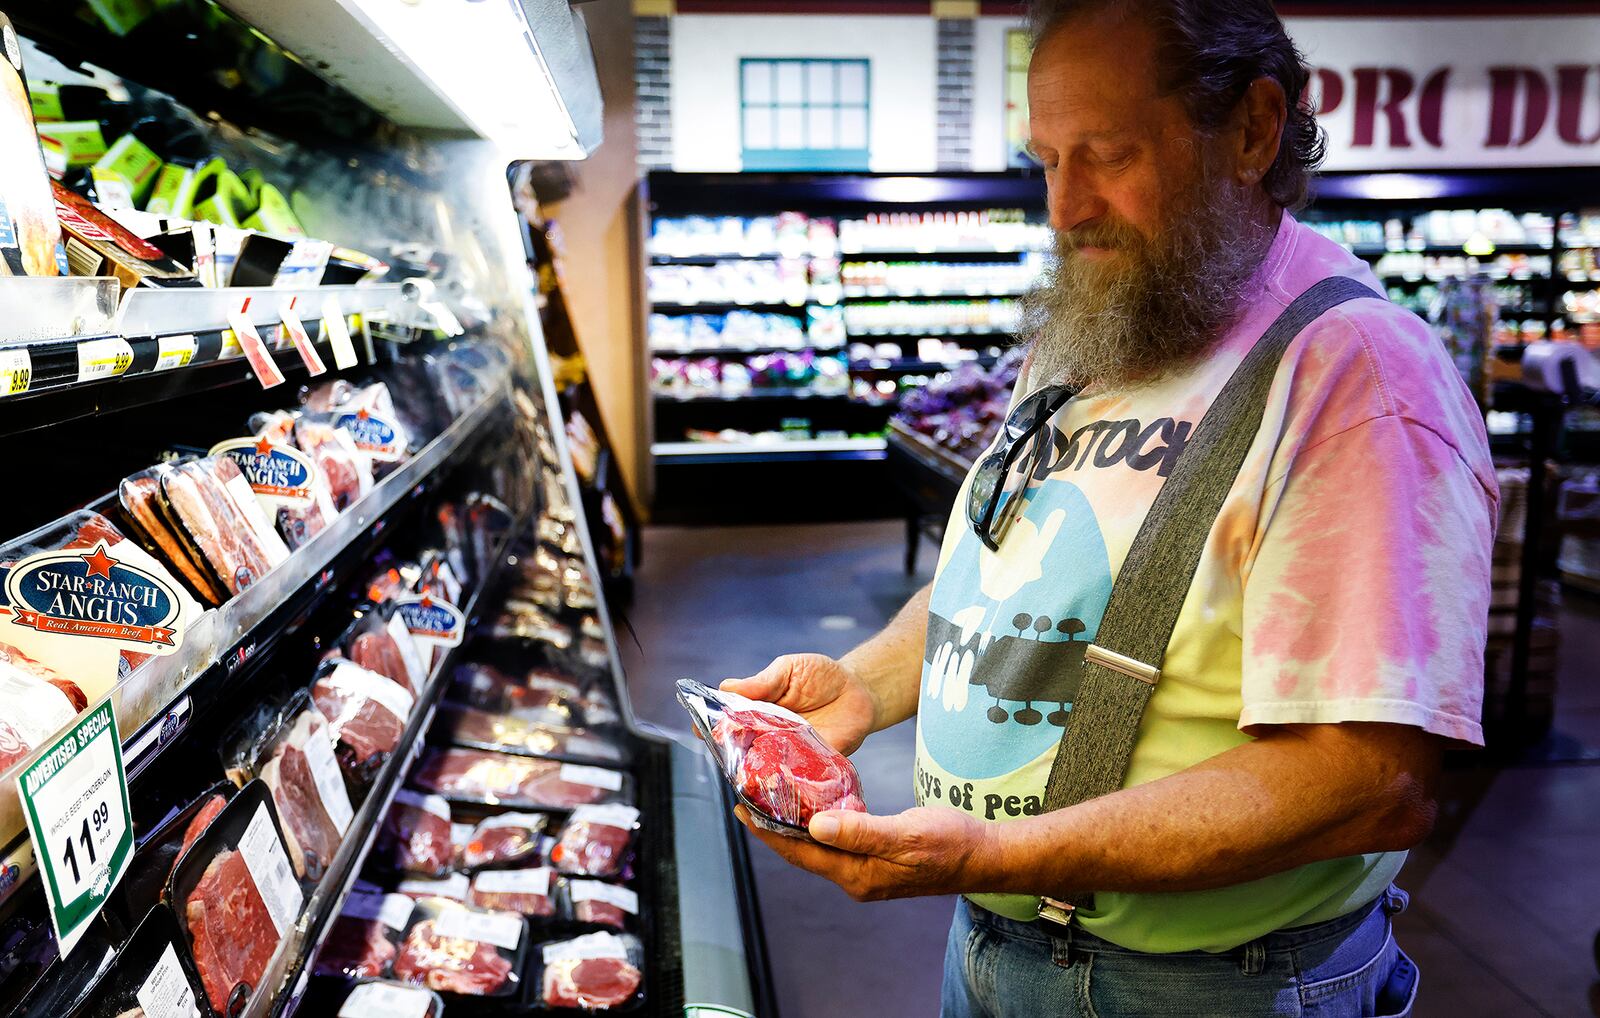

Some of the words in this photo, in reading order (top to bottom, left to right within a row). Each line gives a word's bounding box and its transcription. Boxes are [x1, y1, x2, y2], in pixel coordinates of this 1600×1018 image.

[12, 368, 29, 392] 9.99
[36, 570, 85, 593] STAR
[93, 579, 159, 608] RANCH
[46, 591, 138, 626] ANGUS
[45, 620, 69, 630] Real.
[72, 624, 118, 635] American.
[120, 627, 142, 638] Beef.
[26, 736, 78, 798] ADVERTISED
[77, 707, 112, 748] SPECIAL
[82, 767, 112, 802] TENDERLOIN
[949, 783, 974, 811] of
